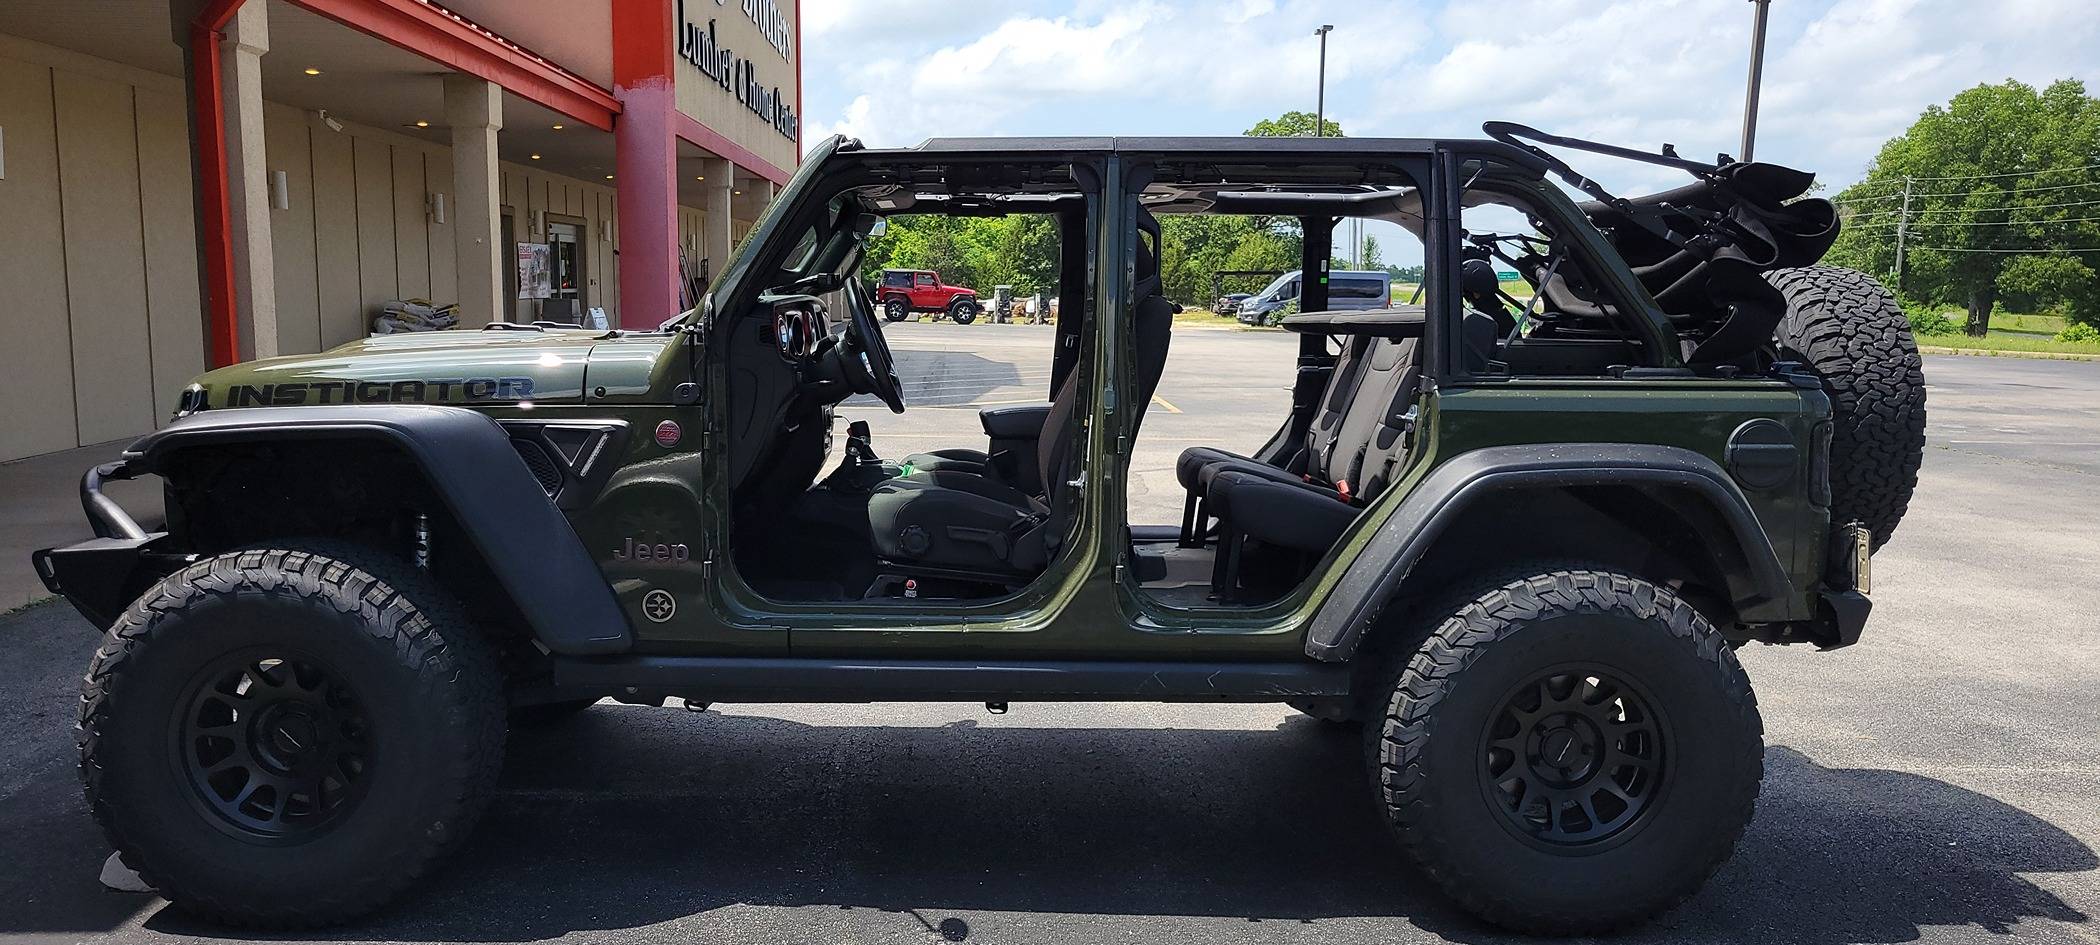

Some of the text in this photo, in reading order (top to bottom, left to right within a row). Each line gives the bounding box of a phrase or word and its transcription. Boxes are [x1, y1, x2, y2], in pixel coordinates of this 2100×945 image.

[678, 0, 733, 92] Lumber
[745, 60, 773, 123] Home
[773, 87, 797, 143] Center
[227, 376, 537, 407] INSTIGATOR
[613, 537, 690, 566] Jeep
